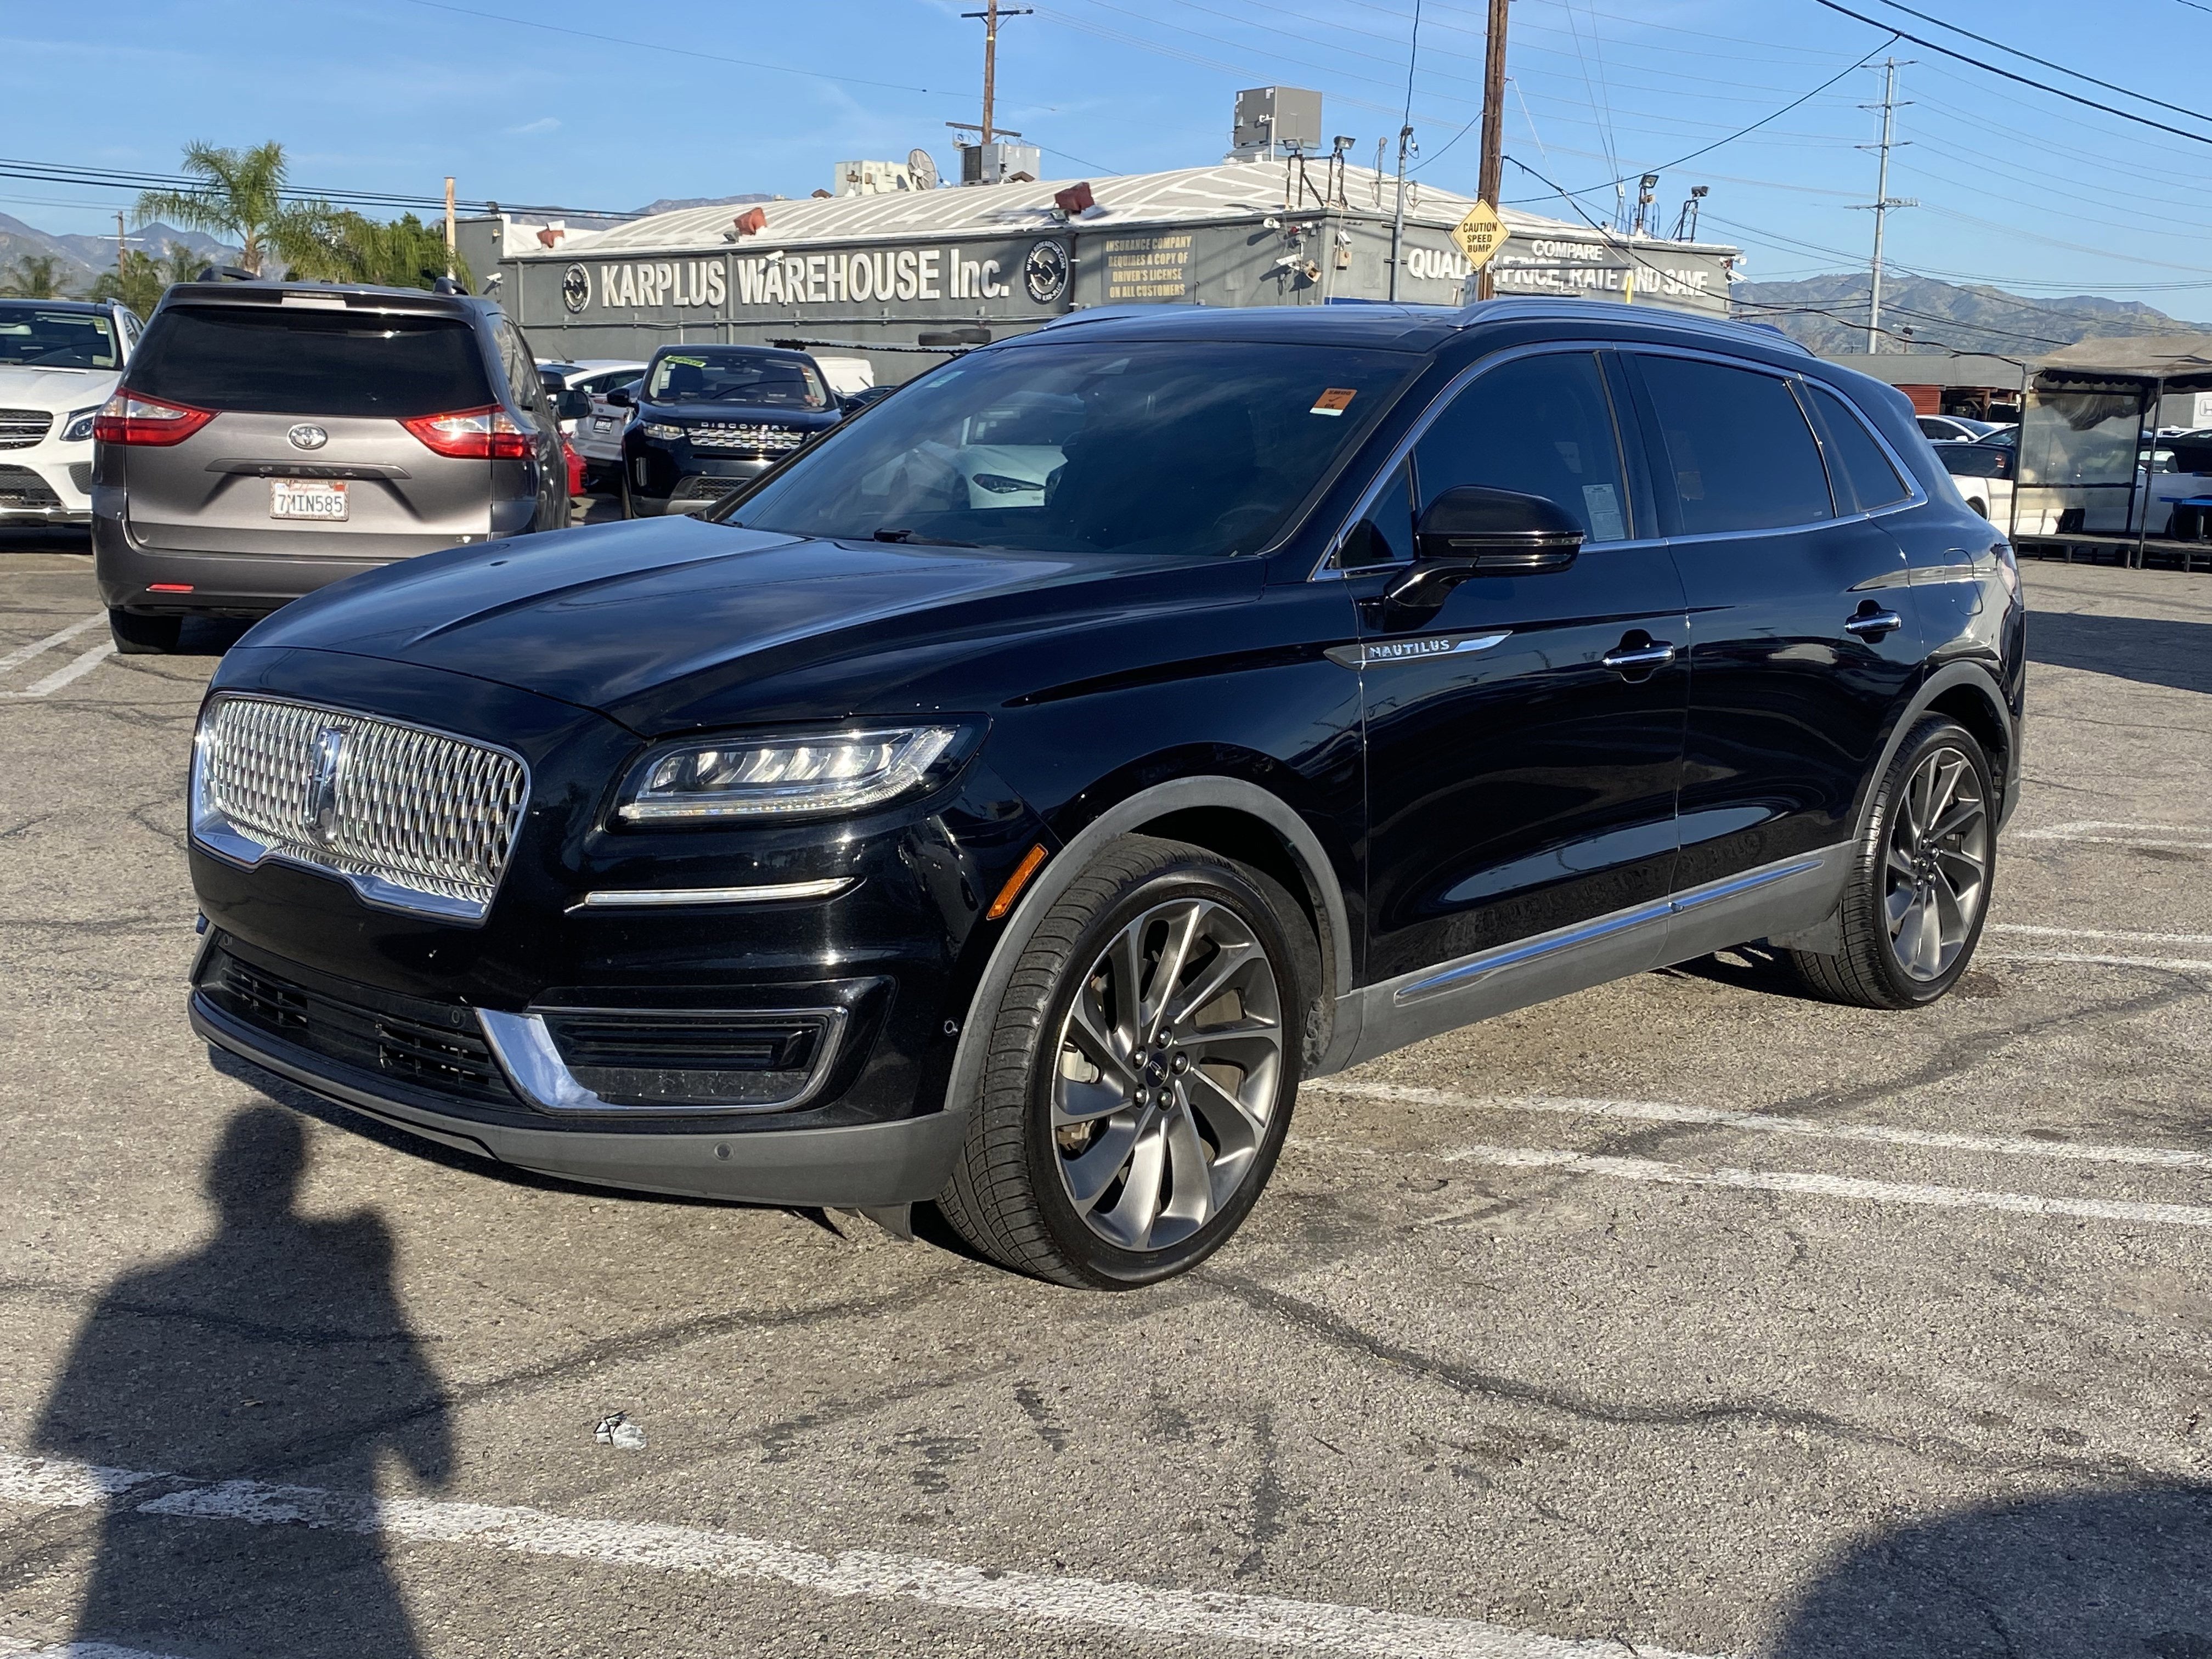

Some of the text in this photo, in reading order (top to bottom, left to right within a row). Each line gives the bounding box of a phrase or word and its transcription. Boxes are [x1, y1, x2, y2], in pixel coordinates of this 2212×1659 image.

[1463, 222, 1497, 233] CAUTION
[1106, 236, 1192, 252] INSURANCE COMPANY
[1466, 234, 1492, 242] SPEED
[1468, 244, 1491, 253] BUMP
[1532, 240, 1604, 261] COMPARE
[1108, 252, 1189, 268] REQUIRES A COPY OF
[601, 261, 726, 307] KARPLUS
[737, 250, 940, 304] WAREHOUSE
[950, 249, 1009, 298] Inc.
[1113, 268, 1182, 282] DRIVER'S LICENSE
[1621, 266, 1661, 292] AND
[1663, 268, 1709, 297] SAVE
[1110, 284, 1186, 298] ON ALL CUSTOMERS
[701, 421, 789, 431] DISCOVERY
[278, 494, 343, 512] 7MIN585
[1369, 640, 1450, 658] NAUTILUS
